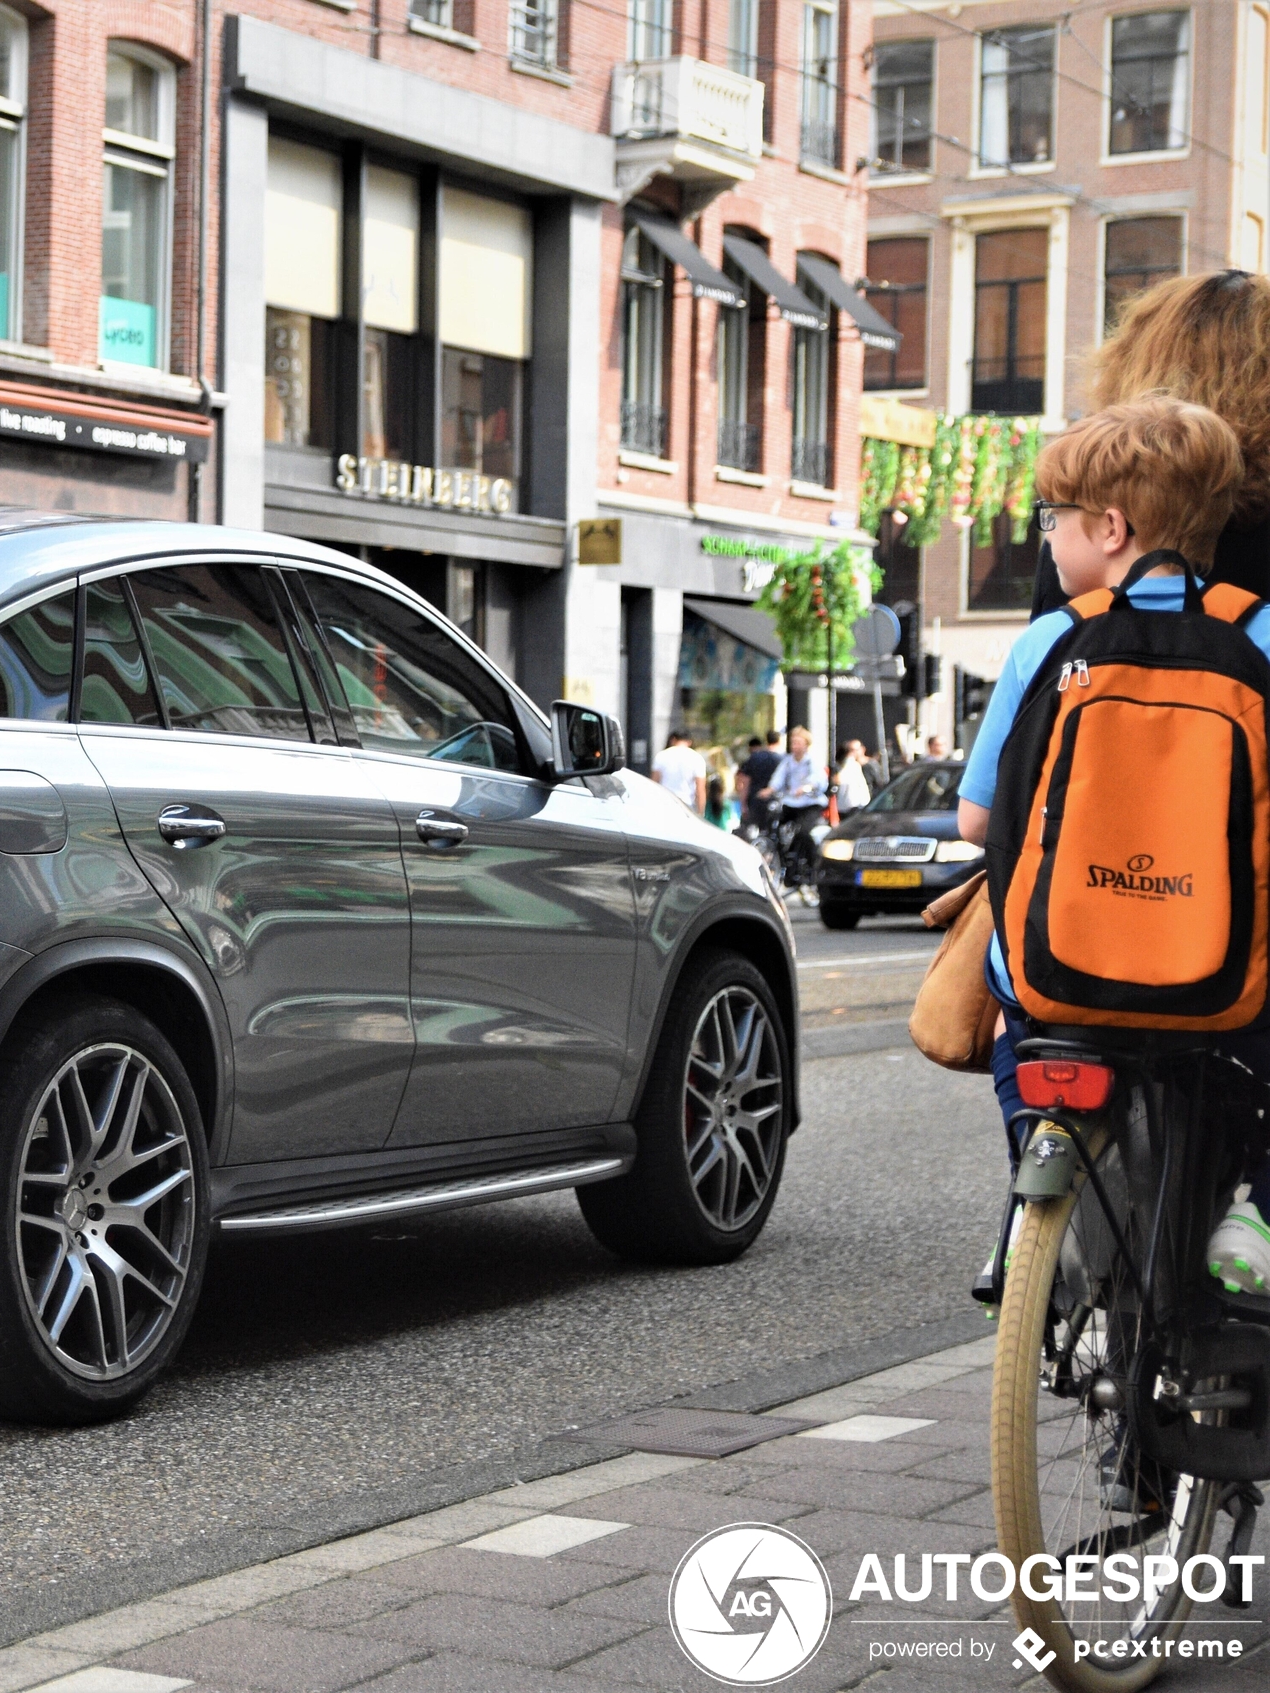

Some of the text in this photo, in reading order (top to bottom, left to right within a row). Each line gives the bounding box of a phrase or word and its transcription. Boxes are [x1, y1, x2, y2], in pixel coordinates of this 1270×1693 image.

[22, 415, 66, 441] roasting
[92, 426, 187, 455] espresso coffee bar
[337, 453, 513, 512] STEINBERG
[1086, 864, 1194, 897] SPALDING
